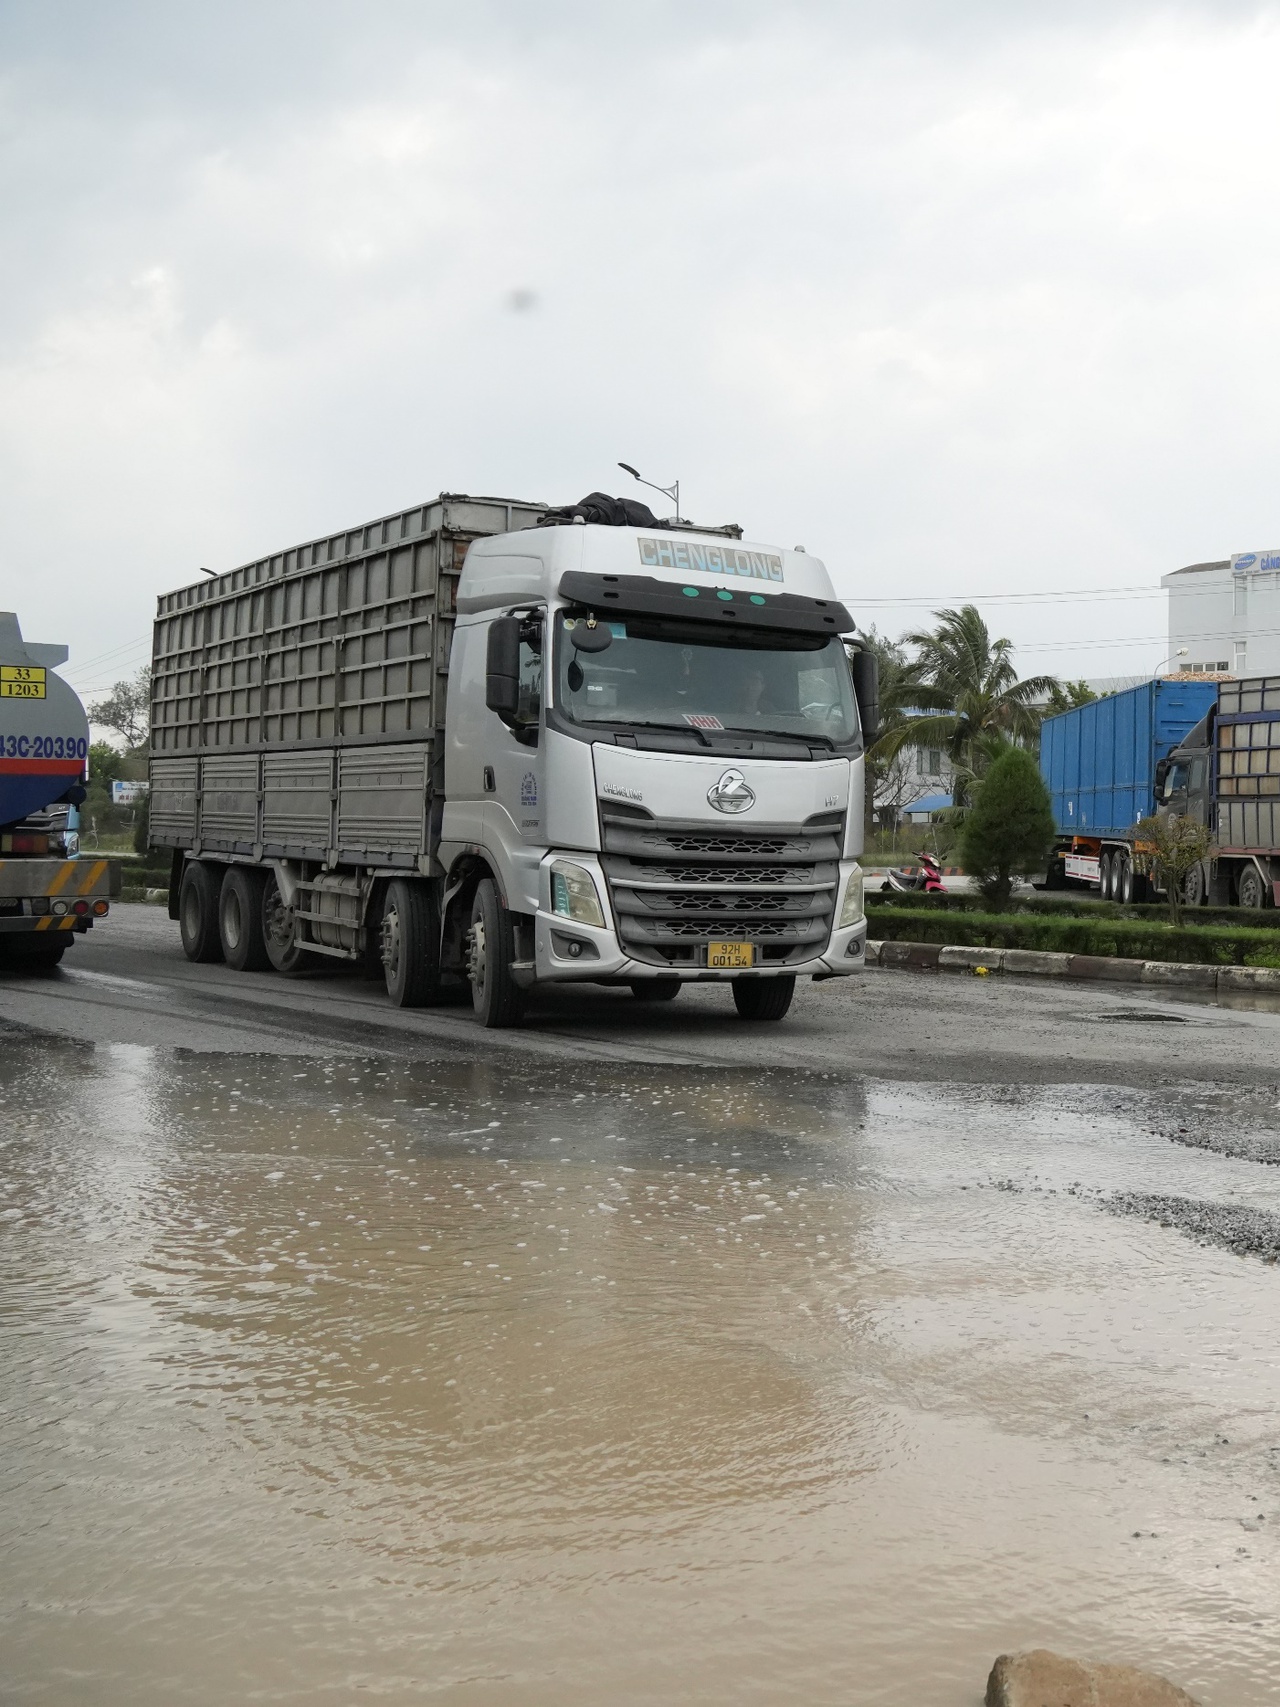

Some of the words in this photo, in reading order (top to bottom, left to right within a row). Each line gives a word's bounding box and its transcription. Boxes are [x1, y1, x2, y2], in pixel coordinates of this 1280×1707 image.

[638, 538, 784, 581] CHENGLONG
[1260, 554, 1280, 571] CẢNG
[14, 668, 31, 680] 33
[7, 684, 39, 696] 1203
[603, 783, 643, 801] CHENGLONG
[721, 944, 741, 955] 92H
[712, 955, 747, 966] 001.54
